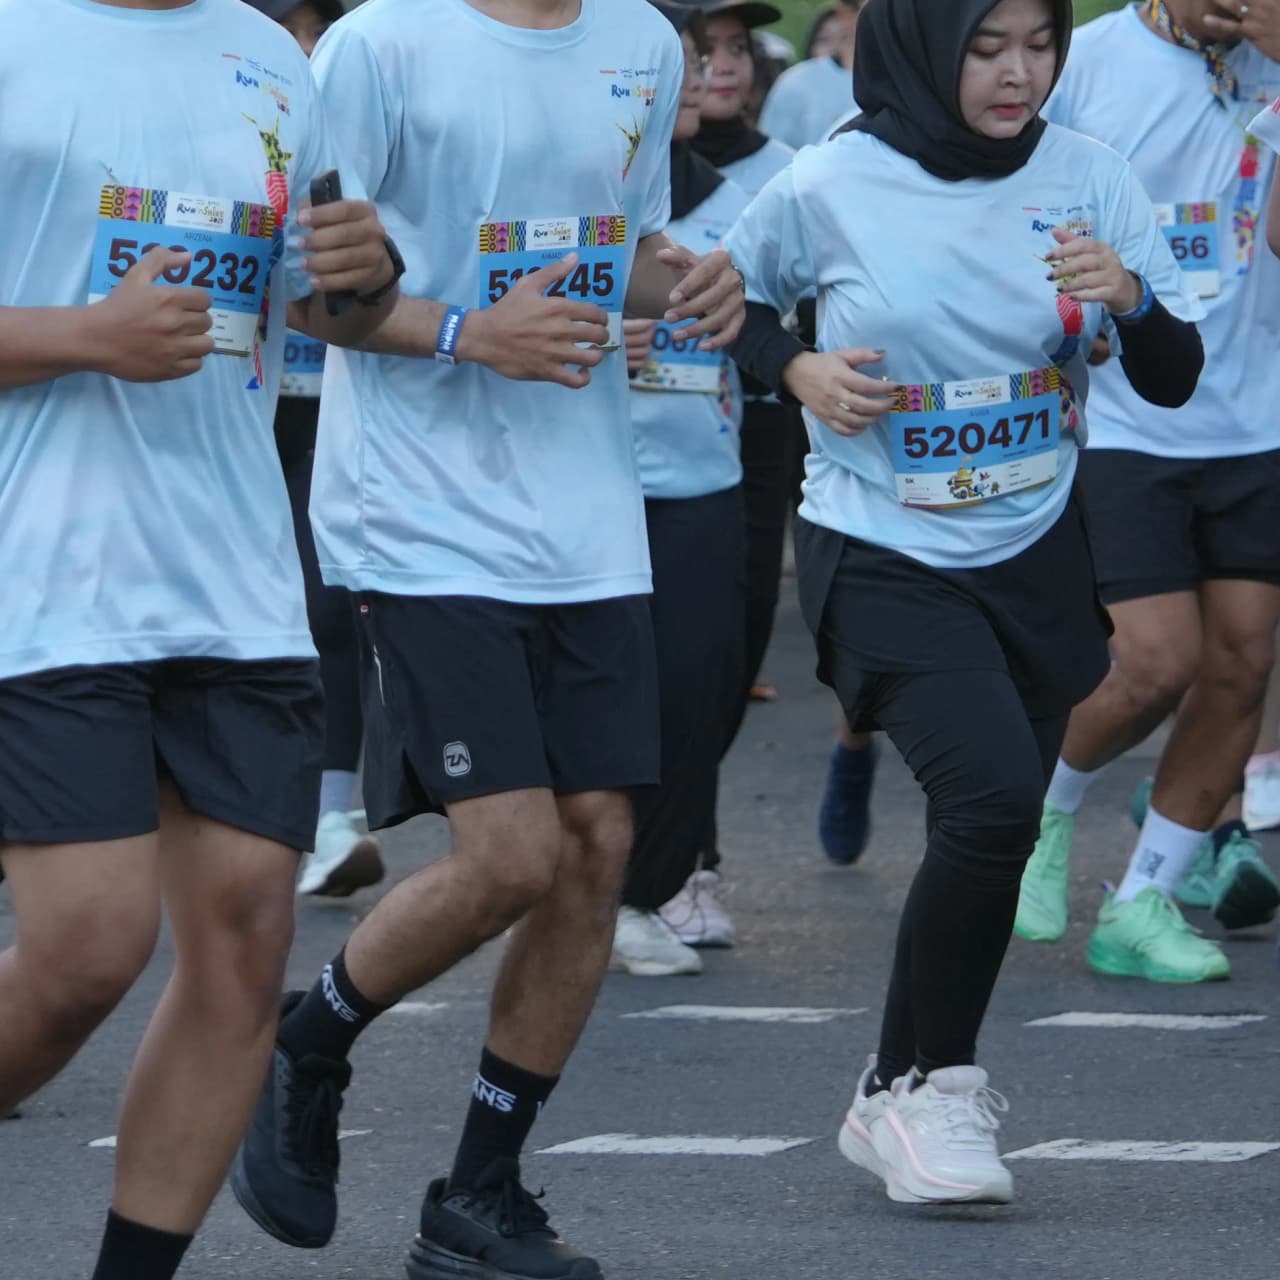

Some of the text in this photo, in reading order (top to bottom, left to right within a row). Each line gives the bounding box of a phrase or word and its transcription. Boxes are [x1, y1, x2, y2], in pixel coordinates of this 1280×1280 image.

[107, 238, 260, 295] 50232
[903, 408, 1050, 459] 520471
[472, 1072, 518, 1113] ANS
